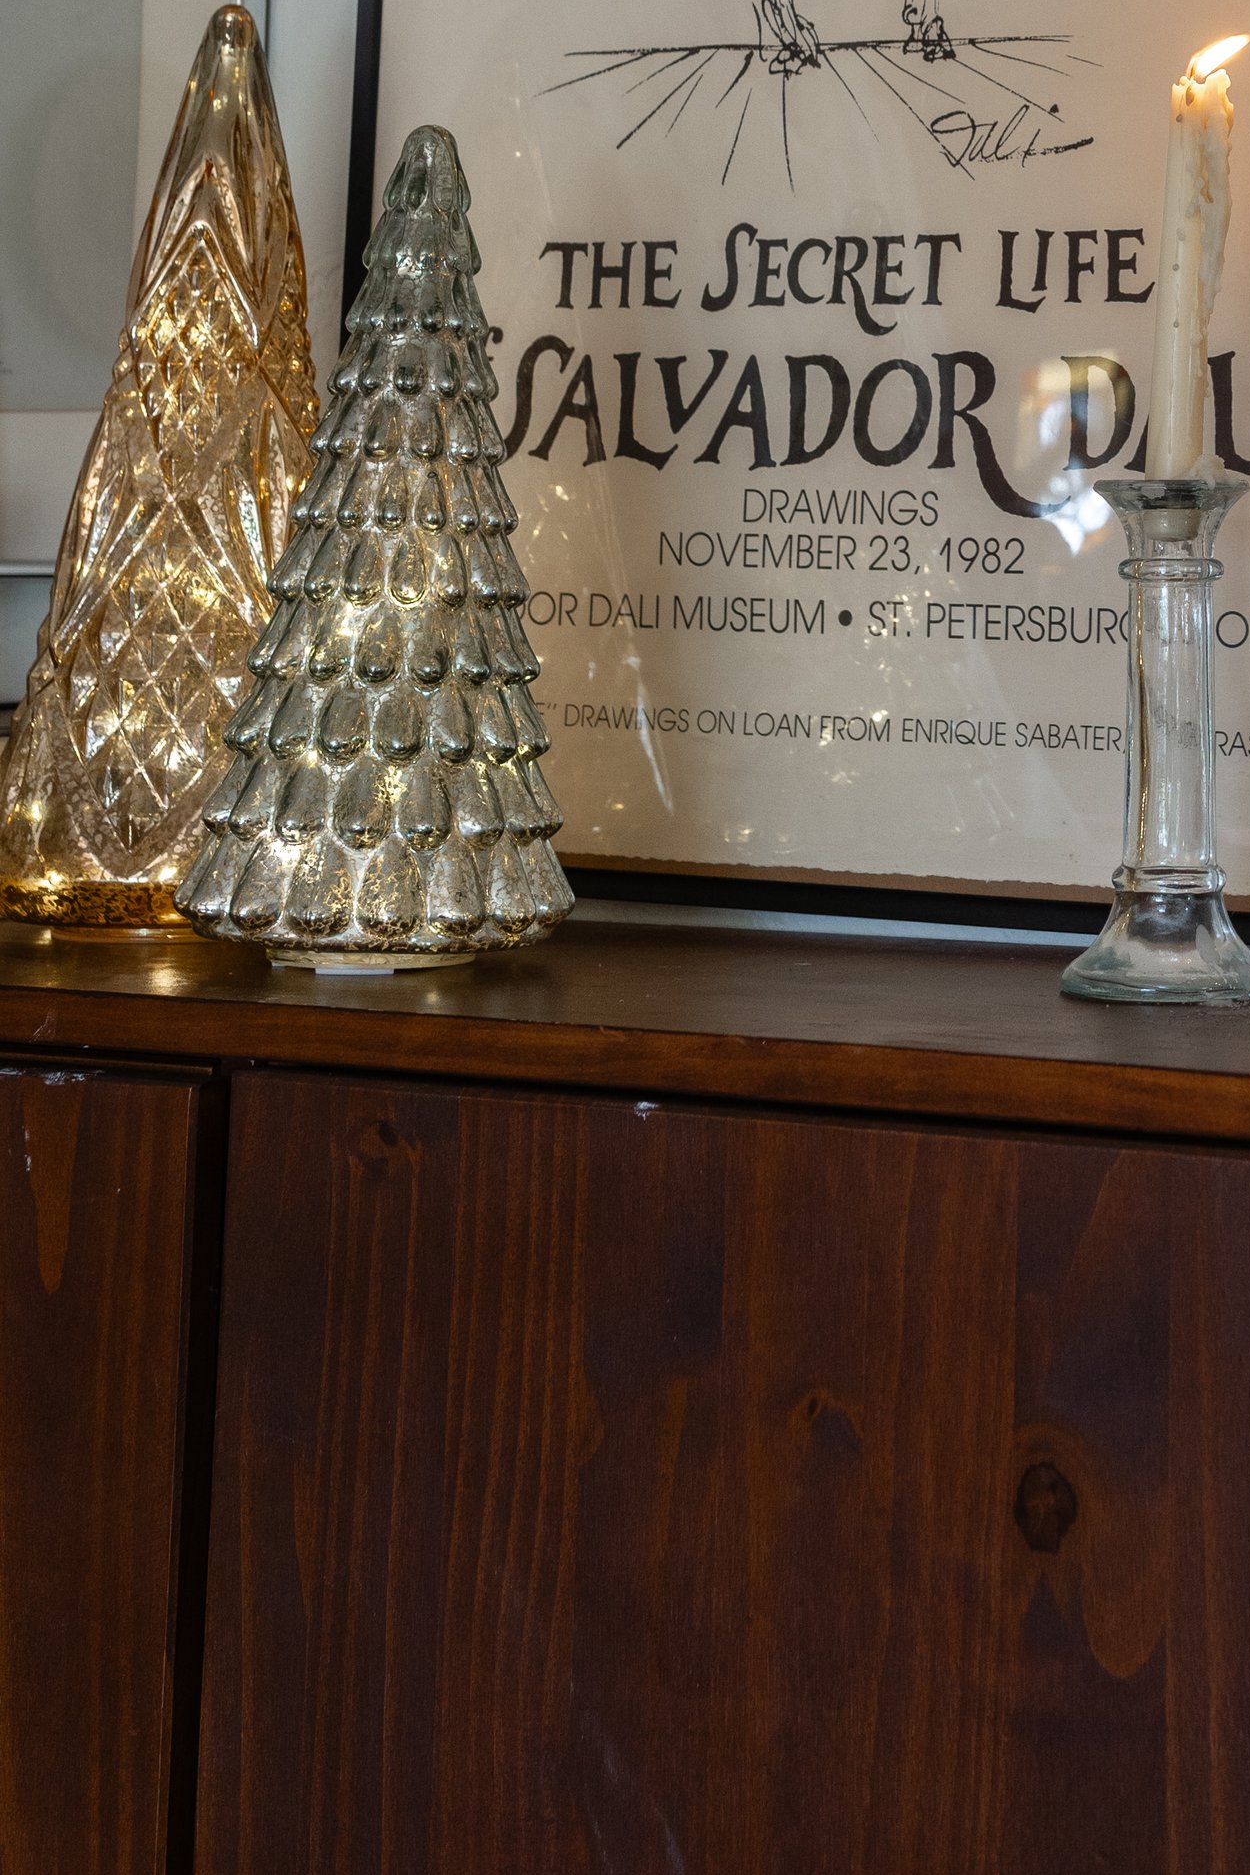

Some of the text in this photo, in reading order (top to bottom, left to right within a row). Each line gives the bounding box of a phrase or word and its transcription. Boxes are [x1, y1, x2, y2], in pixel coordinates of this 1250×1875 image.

[538, 222, 1156, 337] THE SECRET LIFE
[504, 334, 1072, 518] SALVADOR
[743, 488, 939, 527] DRAWINGS
[659, 531, 1025, 575] NOVEMBER 23, 1982
[588, 593, 660, 629] DALI
[672, 595, 825, 634] MUSEUM
[867, 600, 911, 638] ST.
[563, 703, 690, 733] DRAWINGS
[696, 709, 736, 735] ON
[743, 711, 811, 738] LOAN
[819, 714, 891, 742] FROM
[901, 718, 1007, 747] ENRIQUE
